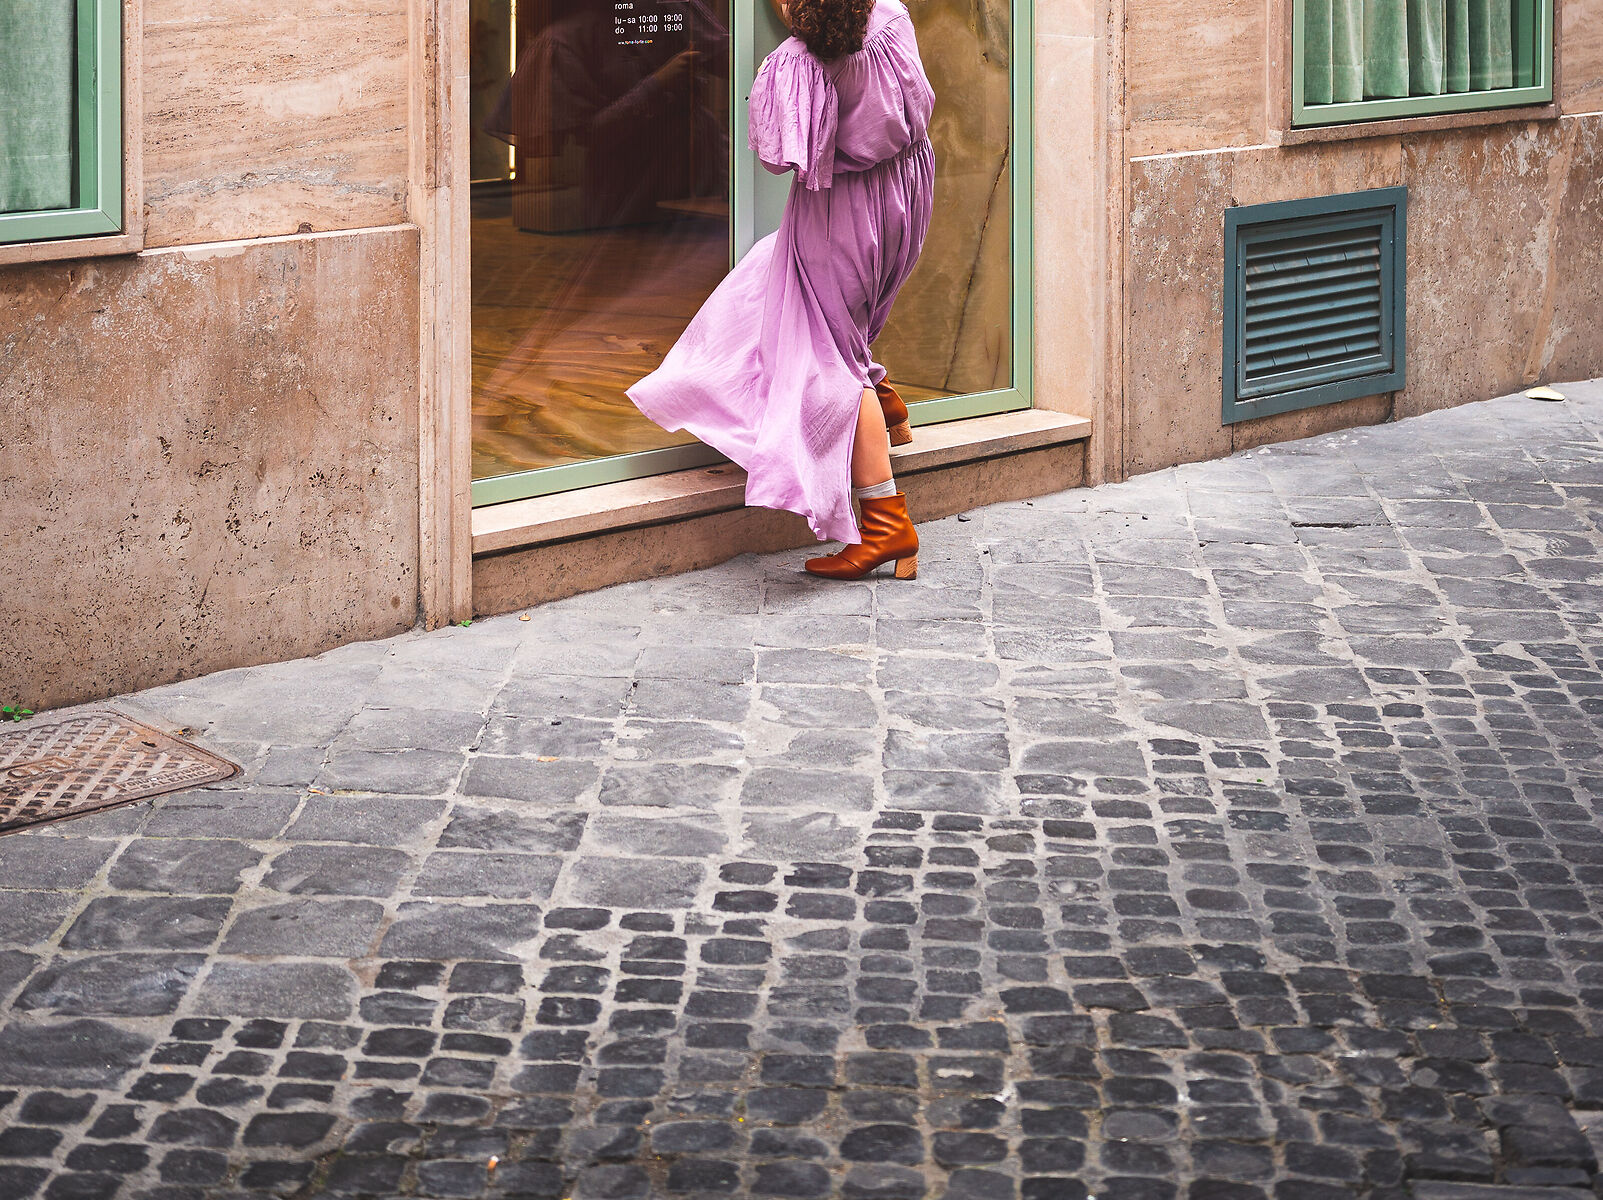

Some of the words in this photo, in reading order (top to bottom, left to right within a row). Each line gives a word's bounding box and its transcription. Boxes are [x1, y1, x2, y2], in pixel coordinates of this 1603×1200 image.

[614, 2, 634, 10] roma
[638, 14, 658, 23] 10:00
[663, 13, 683, 22] 19:00
[614, 26, 625, 34] do
[638, 24, 658, 33] 11:00
[663, 23, 683, 32] 19:00
